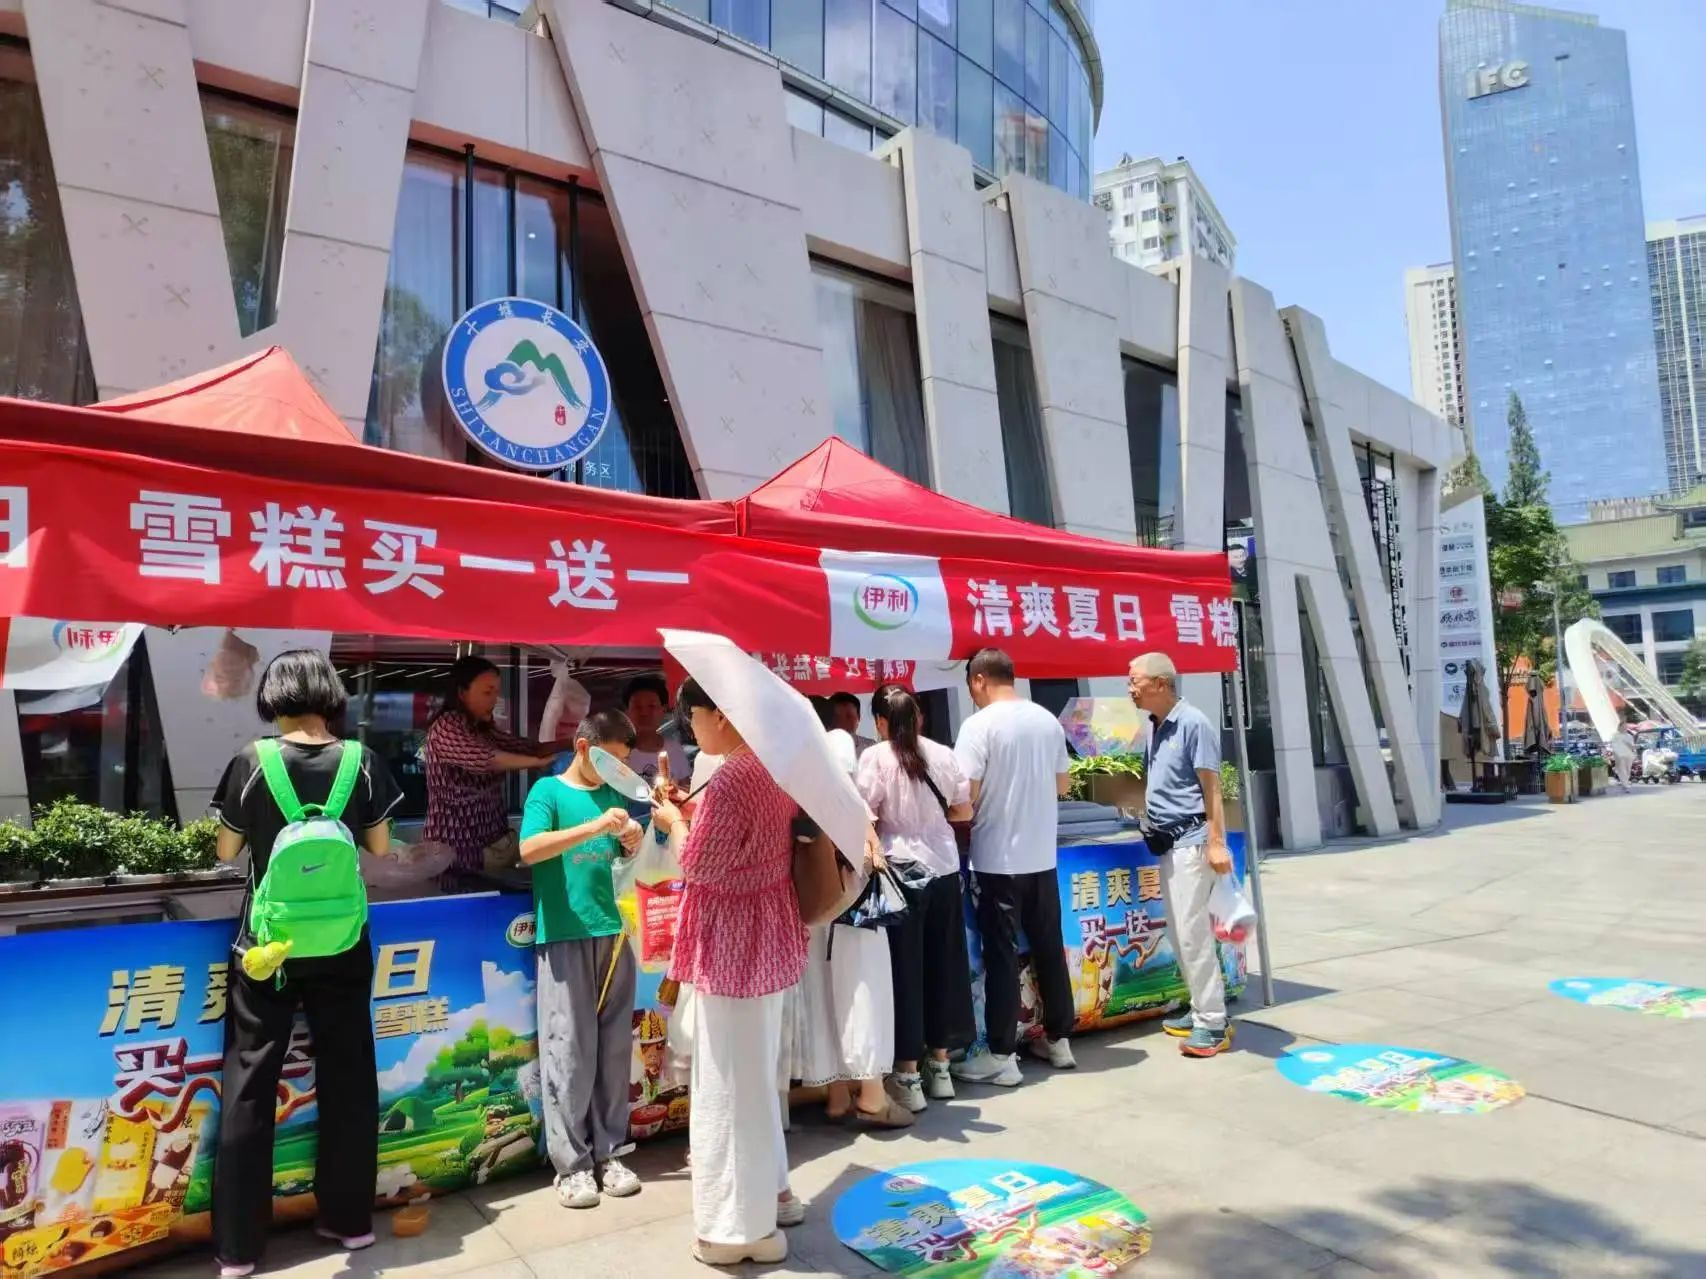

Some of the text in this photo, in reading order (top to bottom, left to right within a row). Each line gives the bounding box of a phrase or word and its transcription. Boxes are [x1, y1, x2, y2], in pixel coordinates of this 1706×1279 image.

[130, 489, 690, 610] 雪糕买一送一
[862, 585, 909, 613] 伊利
[967, 577, 1238, 648] 清爽夏日 雪糕
